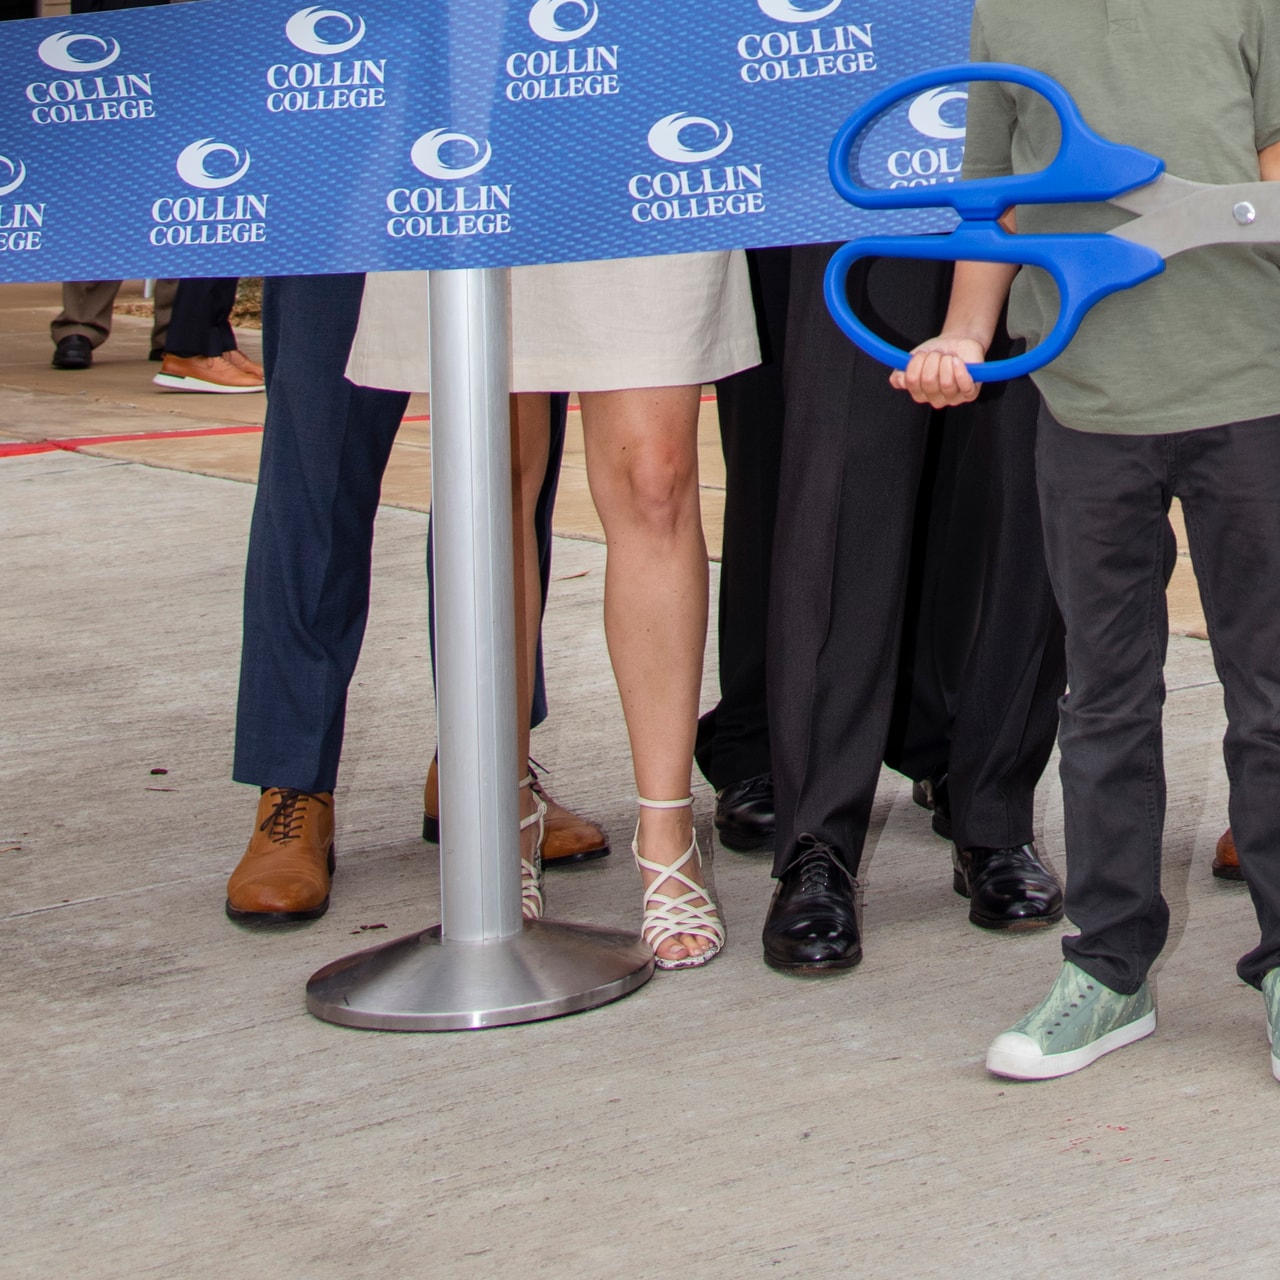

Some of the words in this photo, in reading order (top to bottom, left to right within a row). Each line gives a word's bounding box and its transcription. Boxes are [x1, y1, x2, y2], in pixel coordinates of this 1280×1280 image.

[737, 23, 873, 60] COLLIN
[266, 59, 387, 89] COLLIN
[505, 45, 619, 78] COLLIN
[740, 52, 877, 83] COLLEGE
[25, 72, 152, 104] COLLIN
[266, 87, 387, 112] COLLEGE
[505, 74, 621, 101] COLLEGE
[32, 99, 156, 124] COLLEGE
[628, 164, 763, 200] COLLIN
[152, 194, 269, 223] COLLIN
[386, 184, 512, 214] COLLIN
[631, 192, 766, 223] COLLEGE
[150, 222, 267, 246] COLLEGE
[386, 213, 512, 237] COLLEGE
